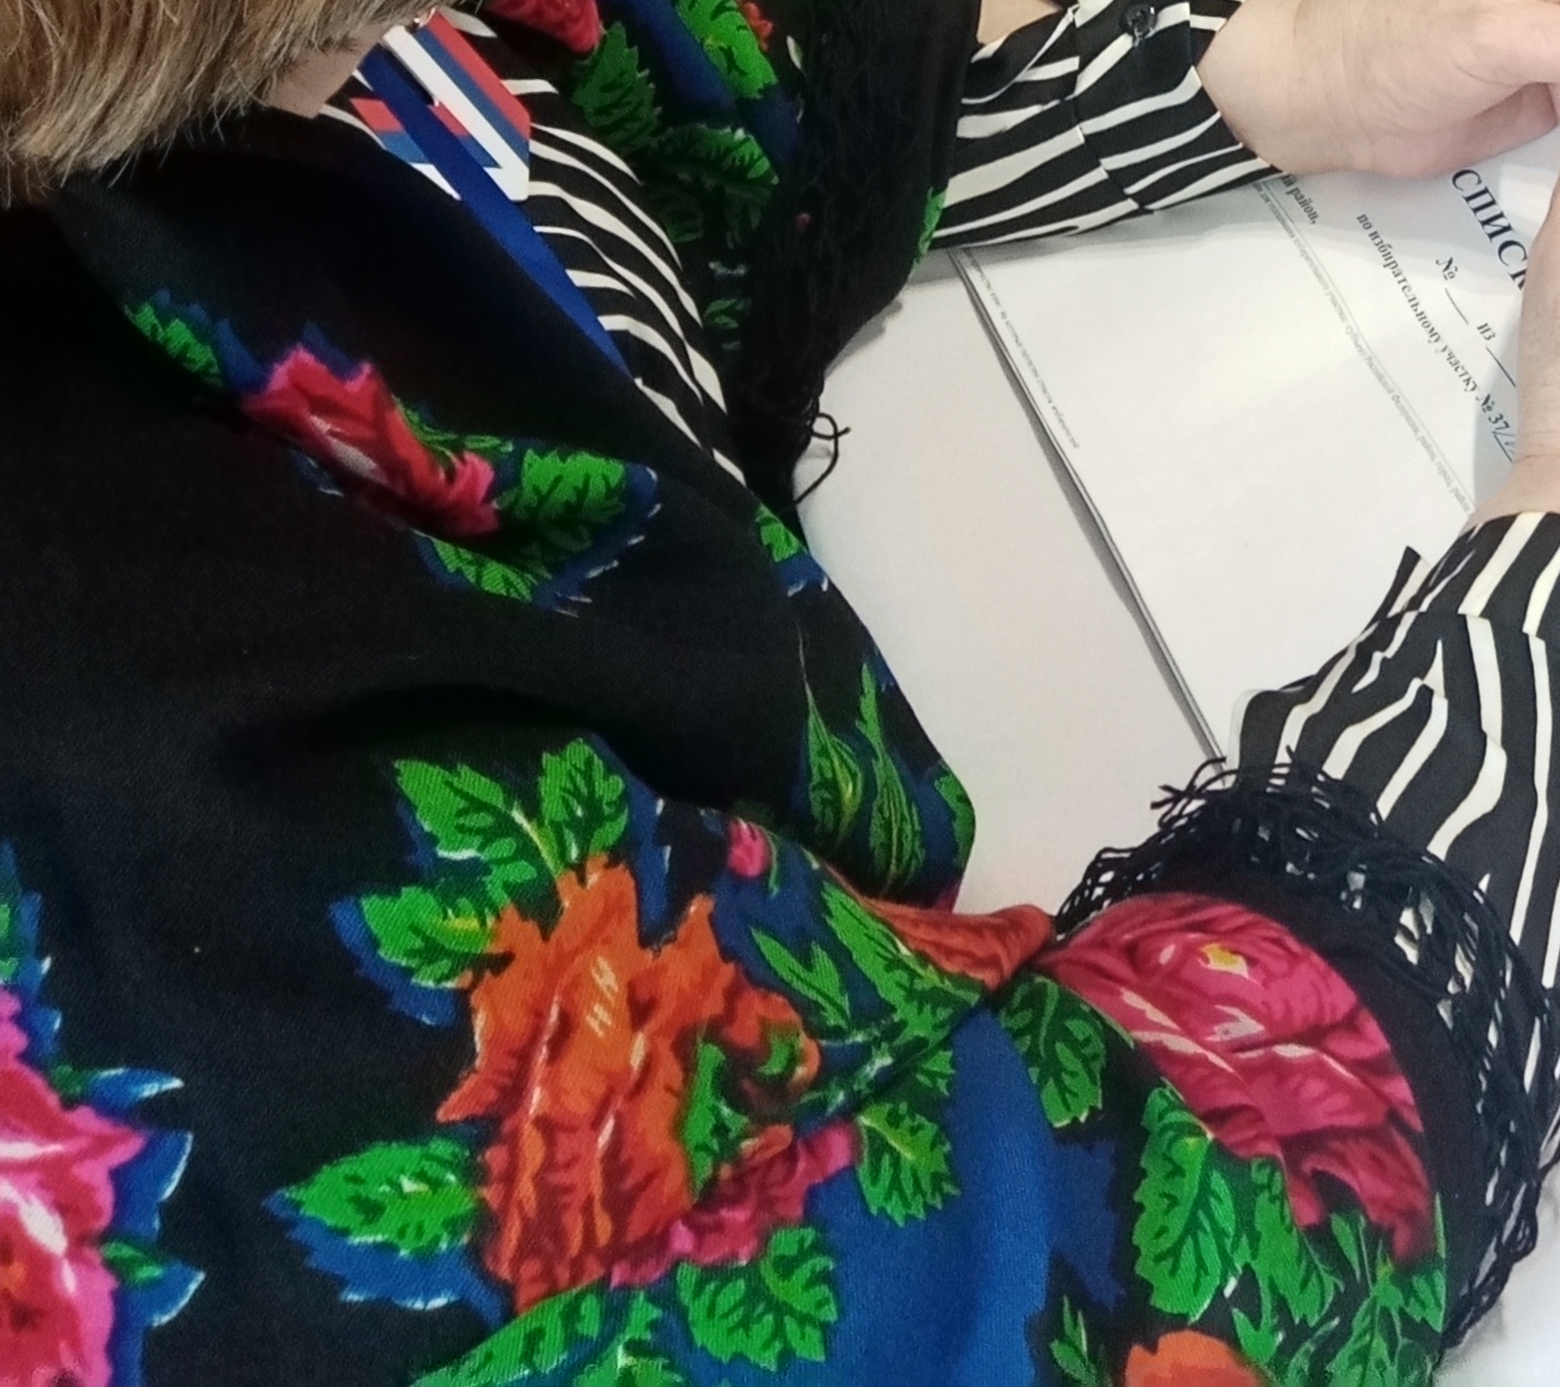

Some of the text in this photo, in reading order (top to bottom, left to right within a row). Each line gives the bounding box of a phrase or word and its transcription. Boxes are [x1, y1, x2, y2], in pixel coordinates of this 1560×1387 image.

[1283, 185, 1319, 225] район,
[1450, 163, 1528, 290] СПИСК
[1355, 212, 1373, 231] по
[1367, 229, 1442, 344] избирательному
[1439, 343, 1478, 392] участку
[1474, 392, 1495, 414] №
[1434, 255, 1496, 341] № из
